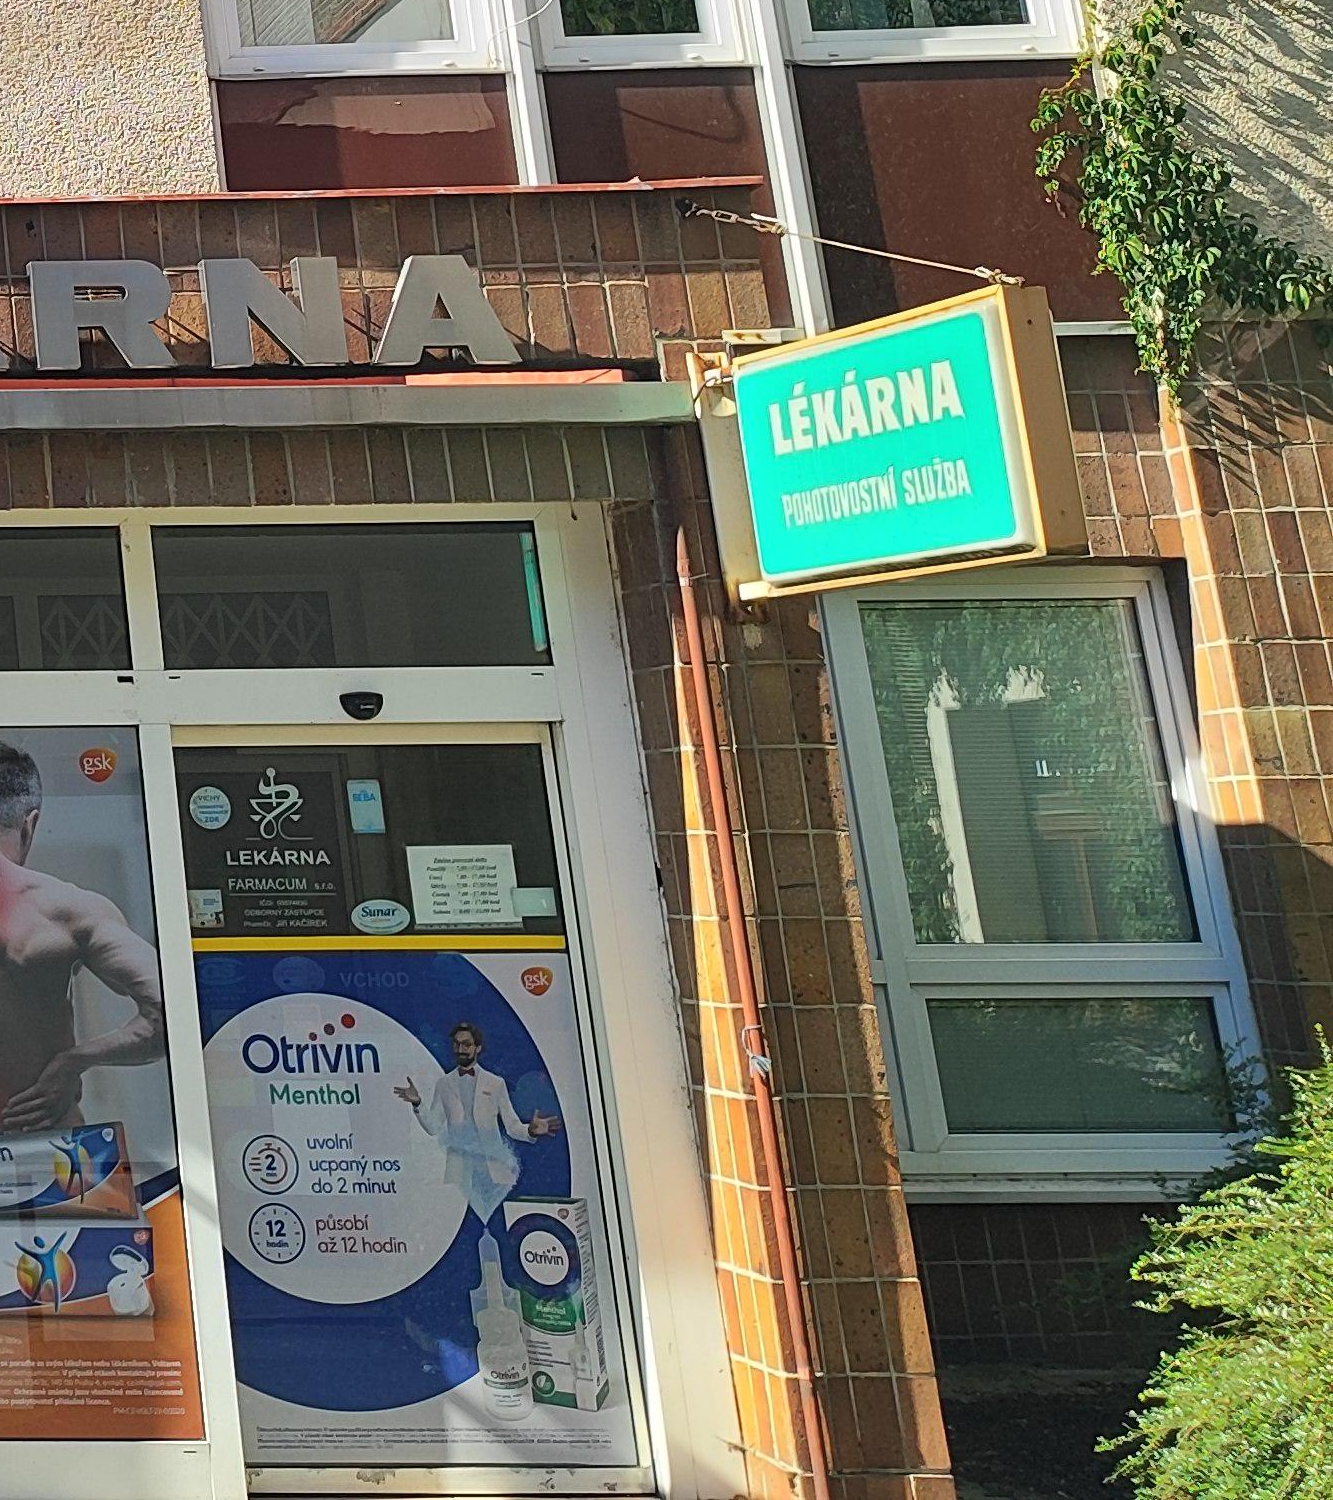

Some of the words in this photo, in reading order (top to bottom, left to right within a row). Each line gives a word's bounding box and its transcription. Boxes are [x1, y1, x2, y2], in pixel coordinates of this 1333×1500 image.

[768, 359, 966, 456] LÉKÁRNA
[780, 464, 899, 529] POHOTOVOSTNÍ
[902, 457, 973, 507] SLUŽBA
[83, 752, 114, 775] gsk
[228, 877, 308, 891] FARMACUM
[361, 906, 398, 918] Sunar
[339, 971, 409, 988] VCHOD
[522, 969, 551, 991] gsk
[241, 1026, 381, 1075] Otrivin
[269, 1082, 361, 1106] Menthol
[306, 1132, 354, 1151] uvolní
[265, 1154, 277, 1171] 2
[308, 1154, 369, 1175] ucpaný
[372, 1159, 402, 1172] nos
[311, 1177, 334, 1194] do
[336, 1178, 348, 1194] 2
[351, 1177, 398, 1195] minut
[265, 1219, 287, 1238] 12
[315, 1213, 370, 1236] působí
[265, 1240, 290, 1249] hodin
[317, 1236, 338, 1254] až
[341, 1237, 358, 1253] 12
[362, 1237, 408, 1254] hodin
[524, 1249, 564, 1266] Otrivin
